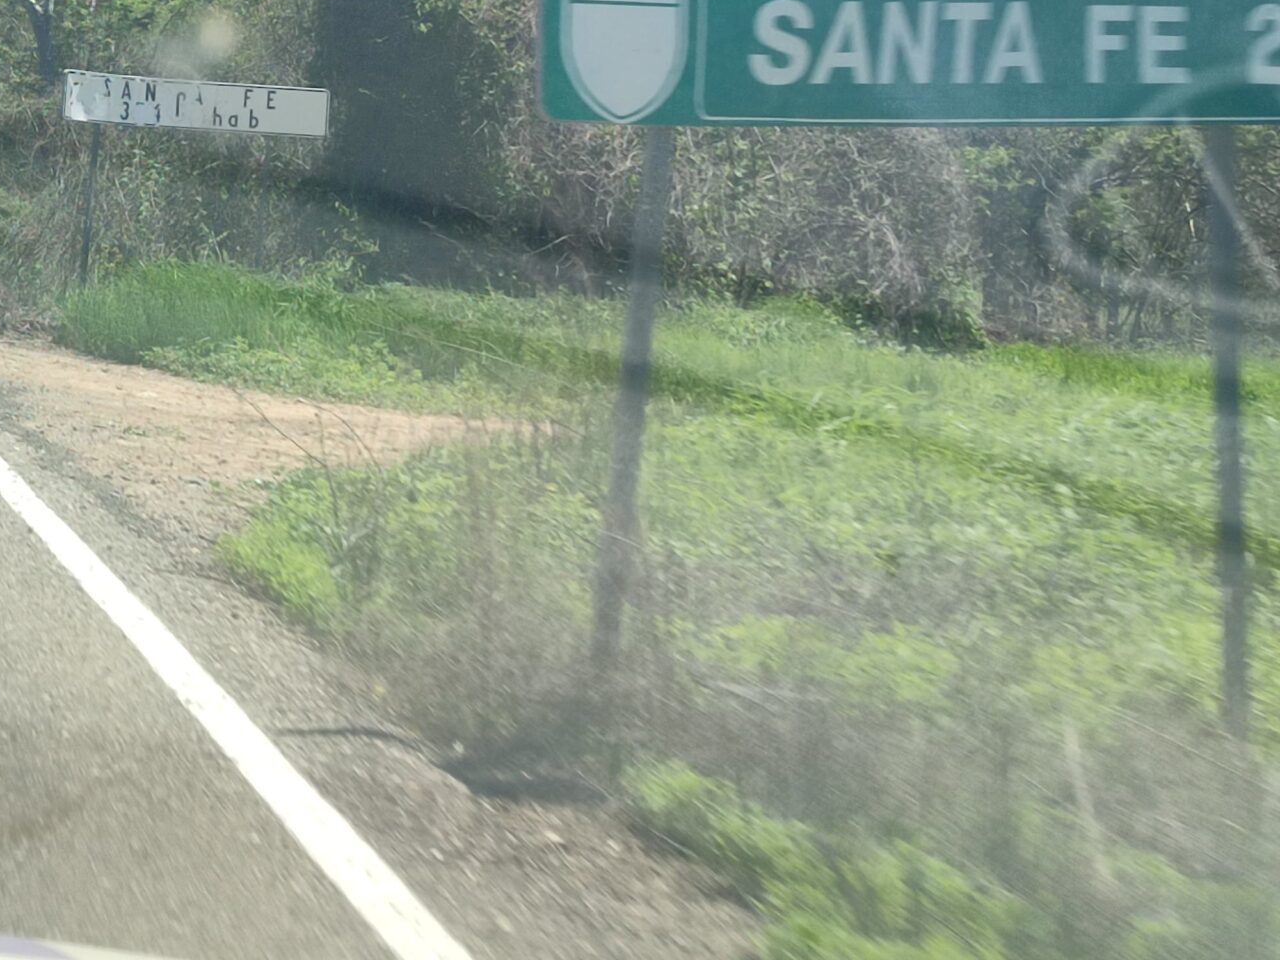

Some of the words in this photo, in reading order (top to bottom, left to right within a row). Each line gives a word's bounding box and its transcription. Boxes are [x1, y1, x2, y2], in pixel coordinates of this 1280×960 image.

[1086, 4, 1190, 85] FE
[243, 88, 277, 110] FE
[212, 106, 259, 129] hab
